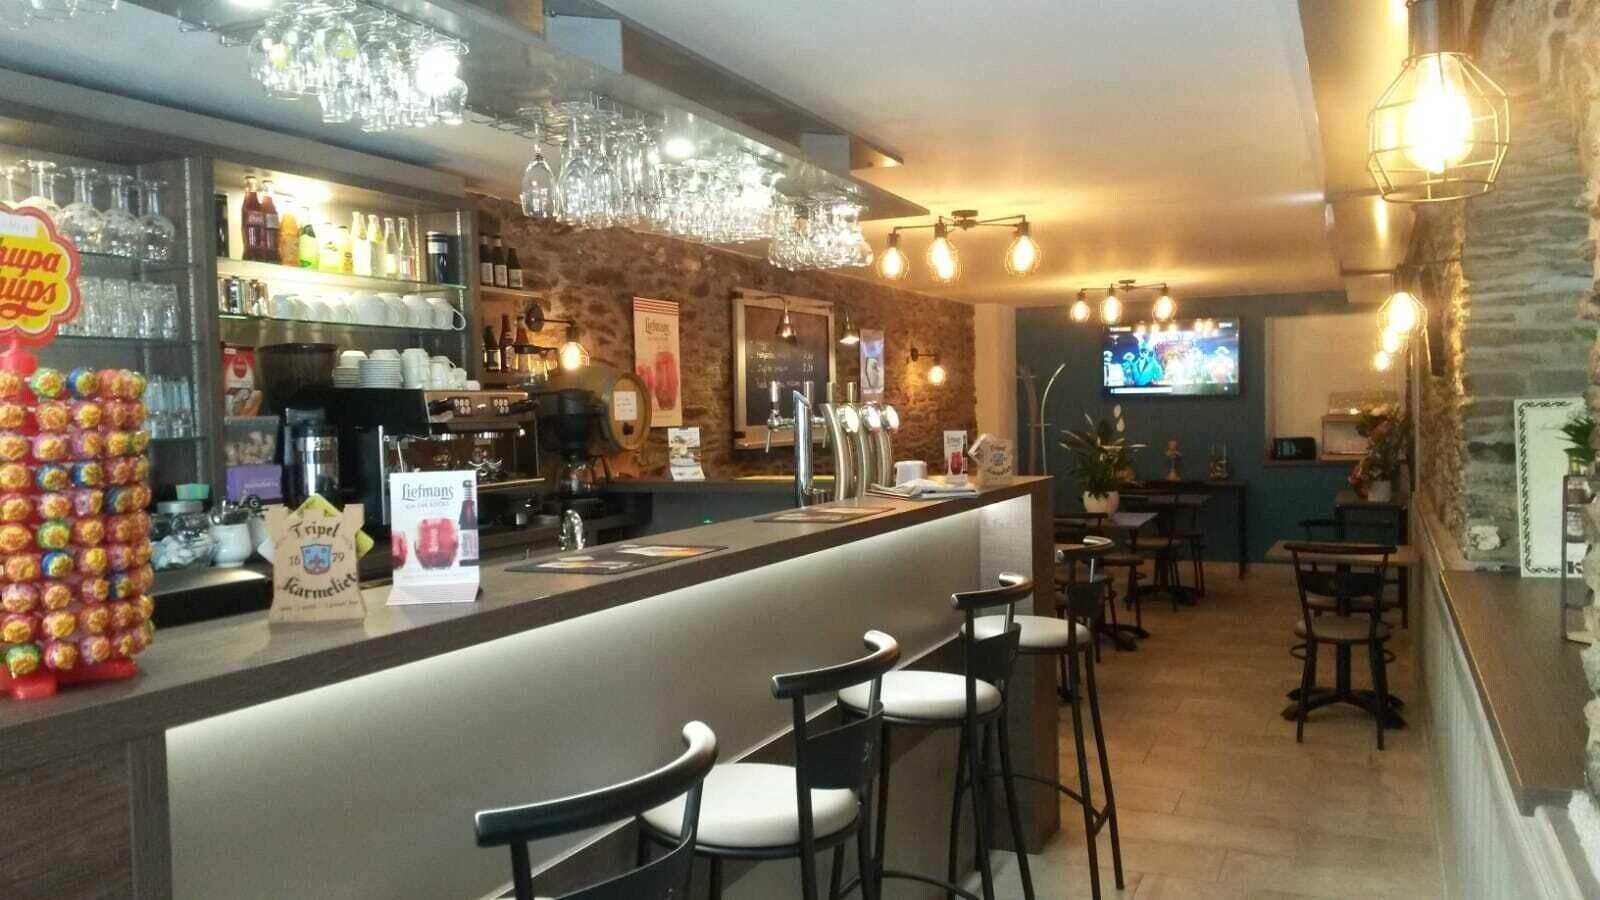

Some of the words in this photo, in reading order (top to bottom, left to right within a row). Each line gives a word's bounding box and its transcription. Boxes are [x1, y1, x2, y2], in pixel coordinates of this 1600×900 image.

[402, 483, 455, 501] Liefmans
[289, 521, 341, 539] Tripel
[288, 555, 301, 566] 16
[331, 552, 345, 563] 79
[282, 573, 358, 599] Karmeliet
